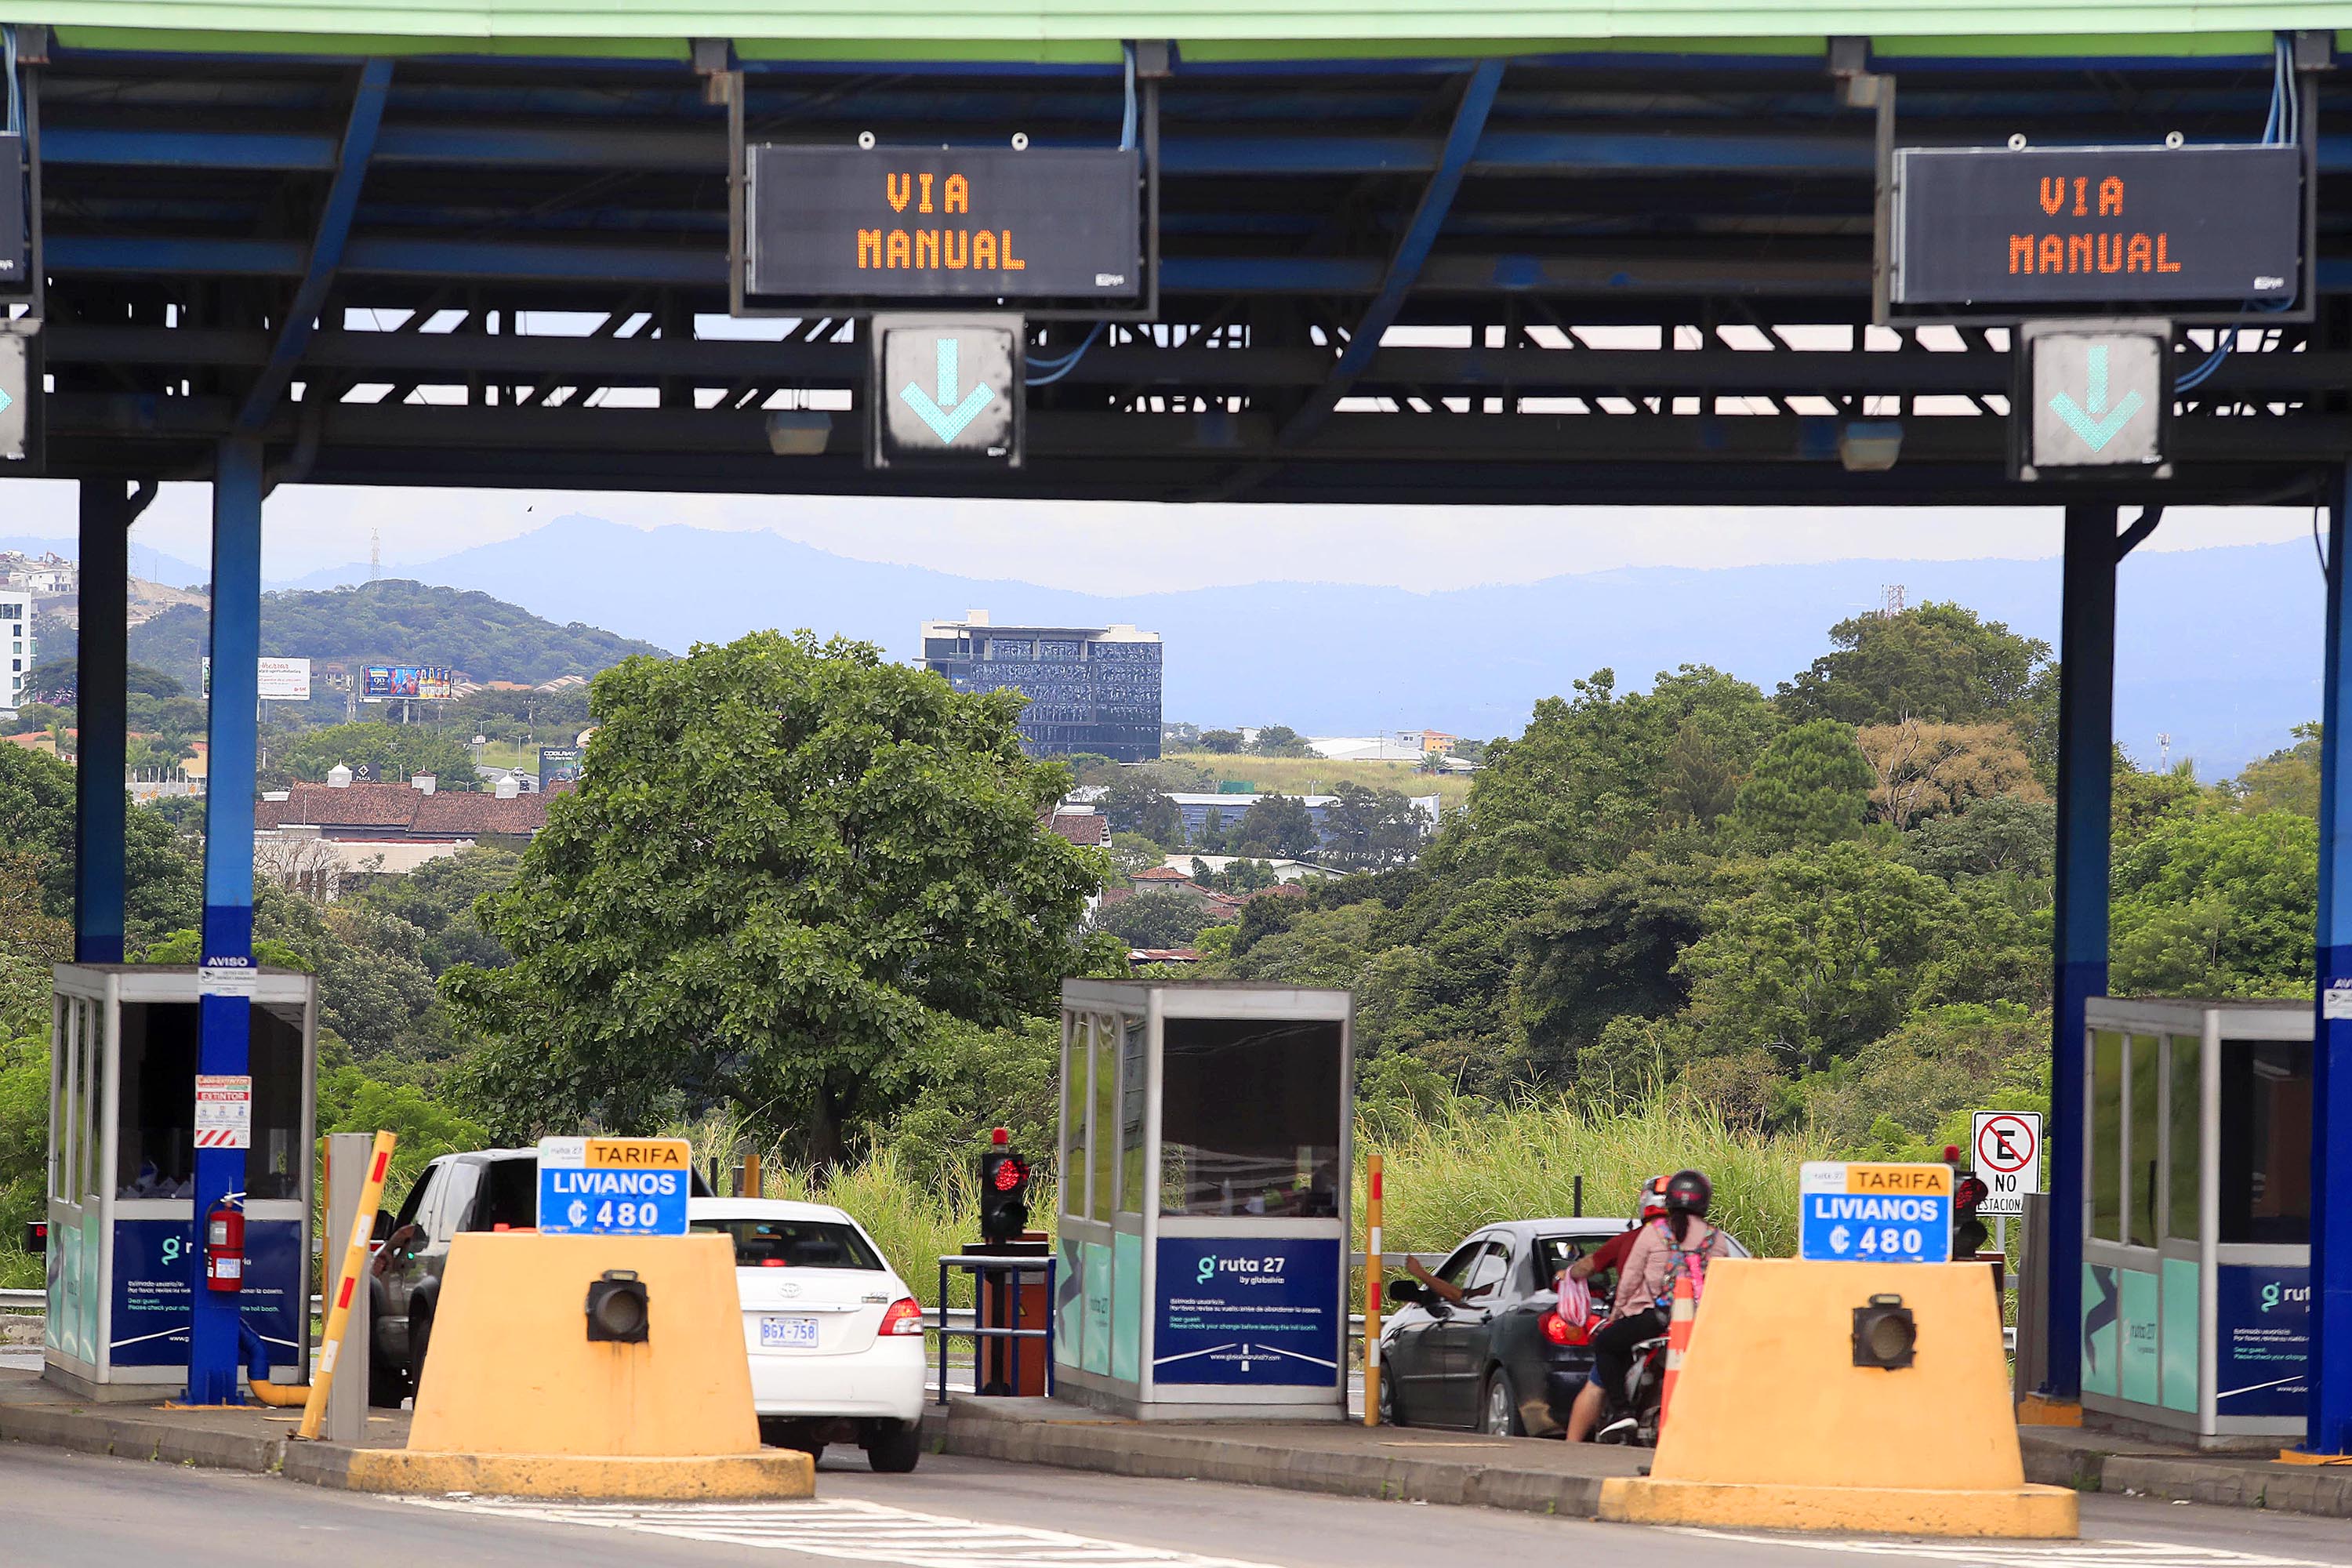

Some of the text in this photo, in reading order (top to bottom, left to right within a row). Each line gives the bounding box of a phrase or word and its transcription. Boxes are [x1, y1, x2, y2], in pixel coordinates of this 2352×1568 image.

[887, 172, 969, 214] VIA
[2040, 176, 2125, 216] VIA
[858, 228, 1025, 270] MANUAL
[2009, 233, 2182, 274] MANUAL
[207, 956, 249, 967] AVISO
[594, 1147, 679, 1163] TARIFA
[554, 1172, 677, 1196] LIVIANOS
[1857, 1171, 1942, 1189] TARIFA
[1995, 1174, 2016, 1192] NO
[596, 1200, 659, 1228] 480
[1815, 1196, 1940, 1222] LIVIANOS
[1859, 1225, 1923, 1254] 480
[1219, 1258, 1259, 1272] ruta
[1263, 1257, 1286, 1273] 27
[763, 1323, 815, 1340] BGX-758
